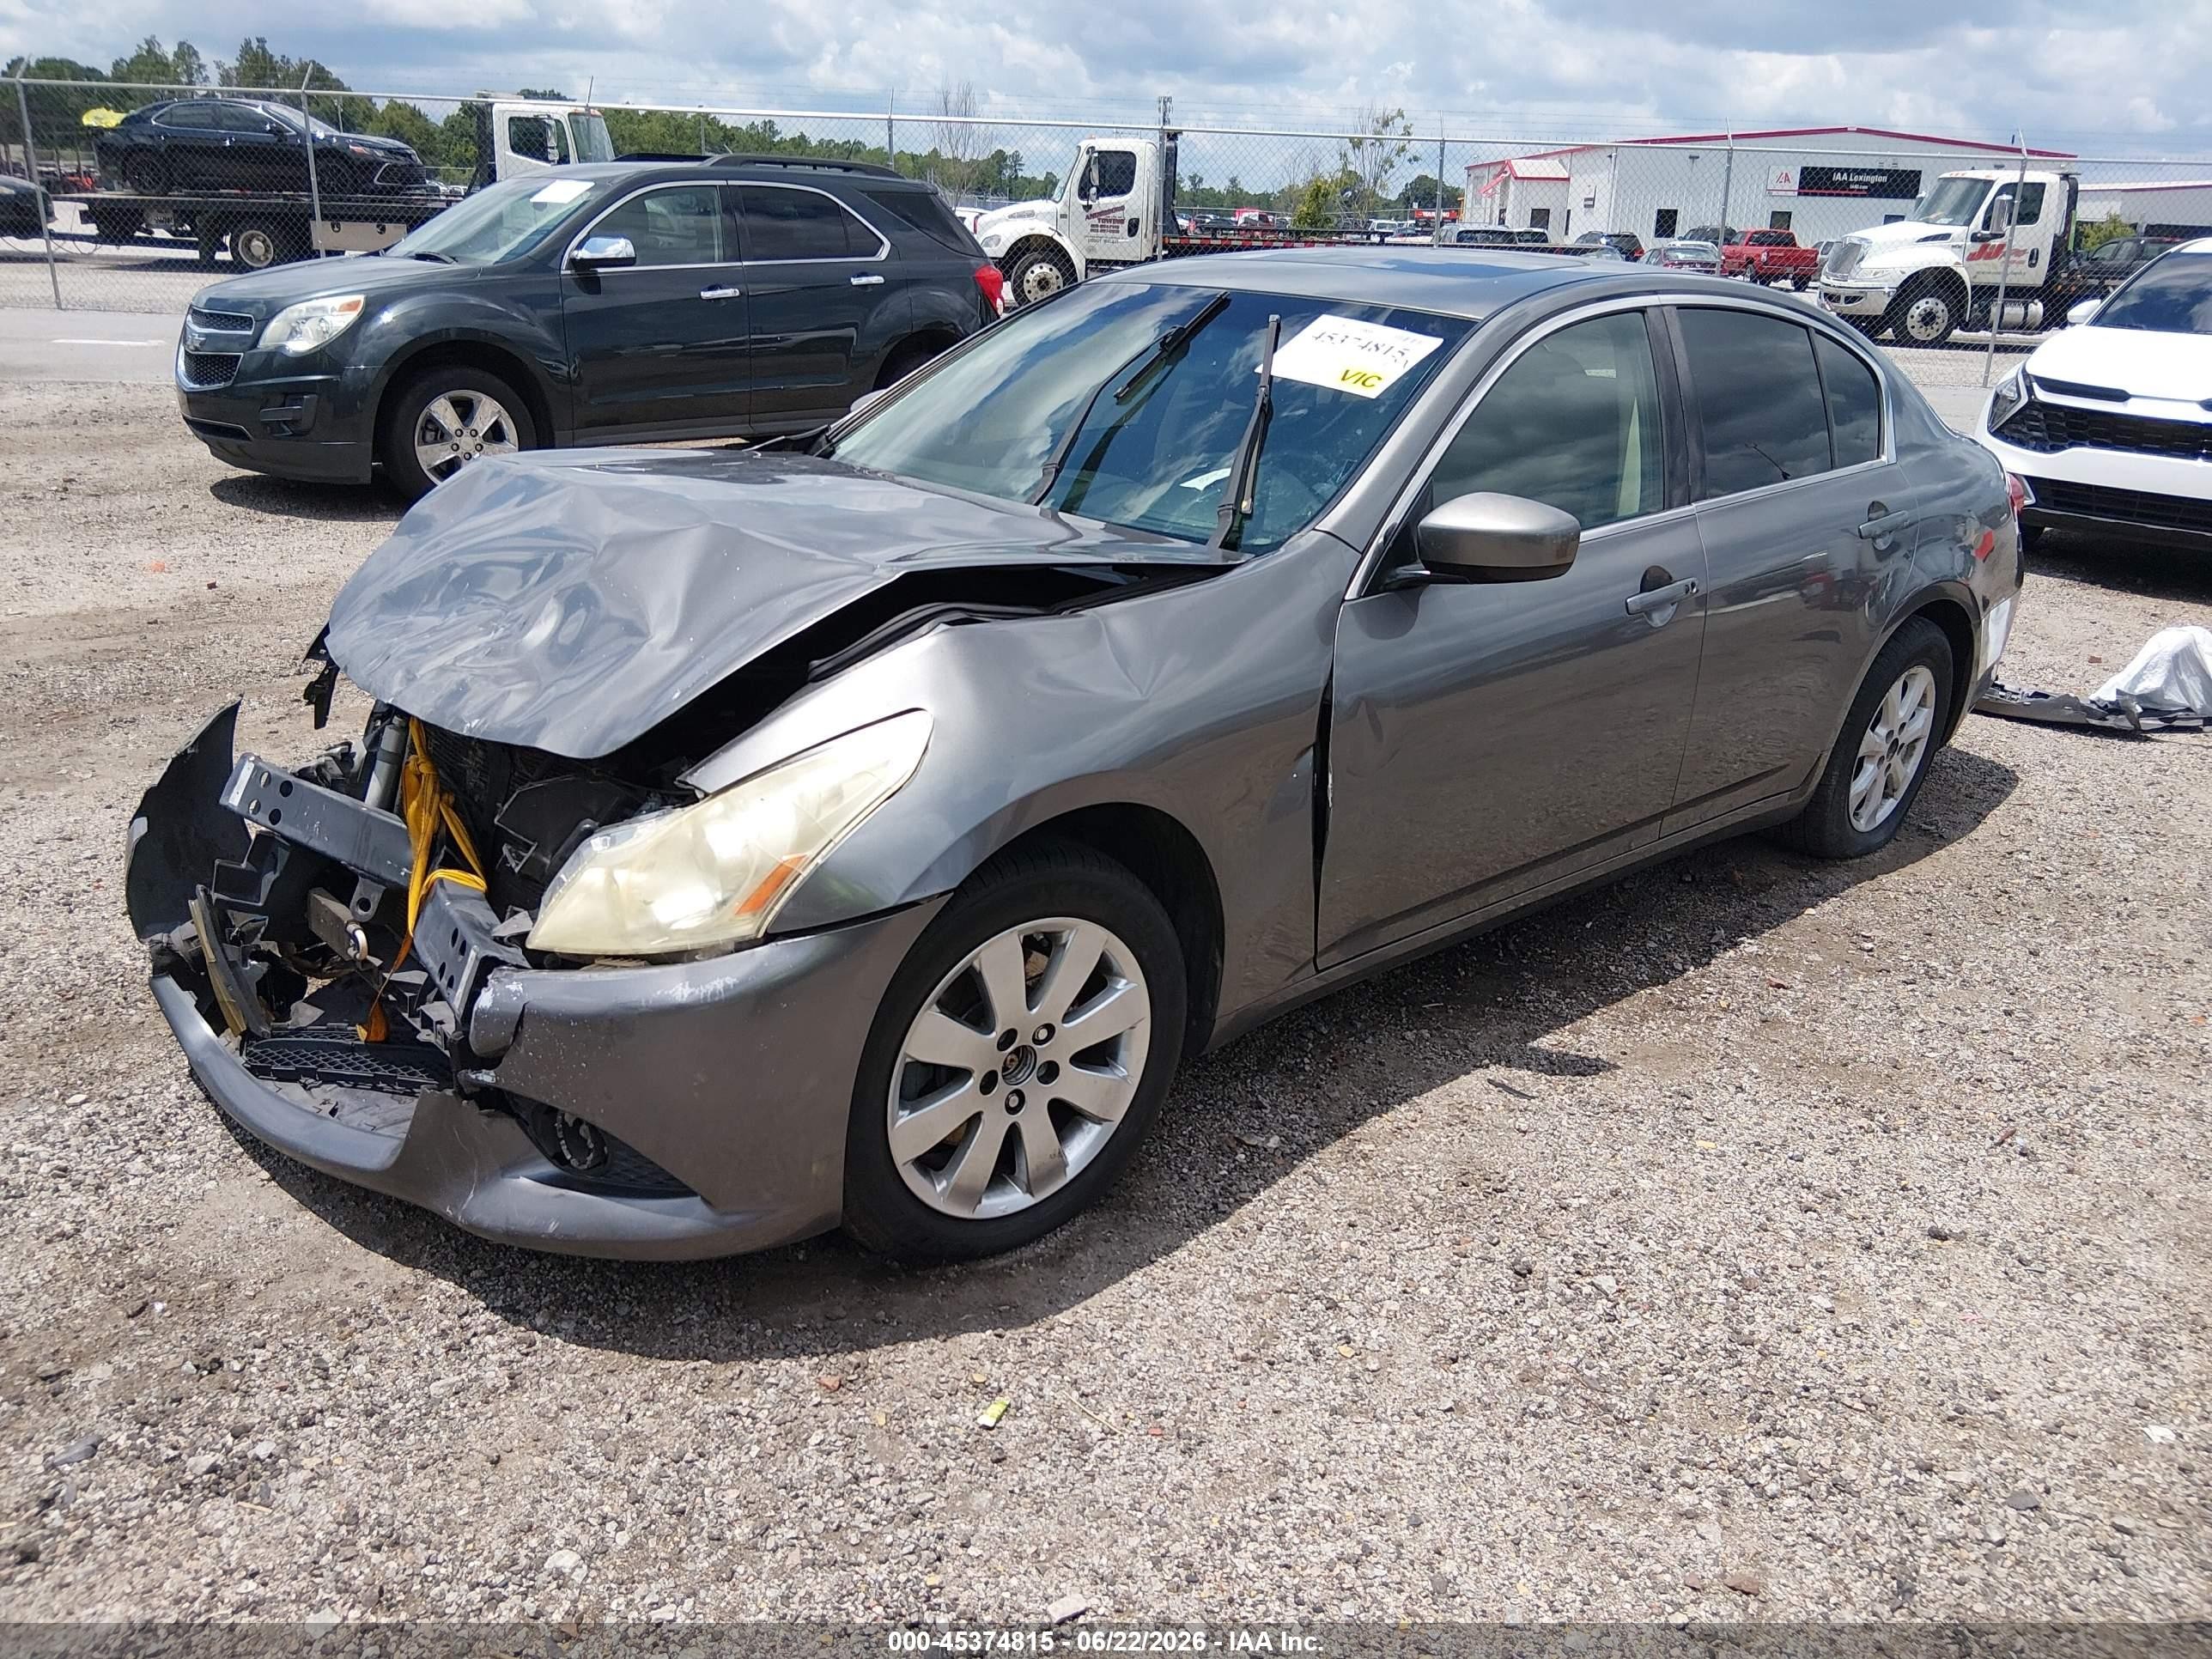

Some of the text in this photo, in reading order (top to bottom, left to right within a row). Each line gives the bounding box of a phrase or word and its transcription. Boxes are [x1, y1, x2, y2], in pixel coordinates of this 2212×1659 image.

[1832, 172, 1887, 185] IAA Lexington
[1340, 368, 1382, 388] VIC
